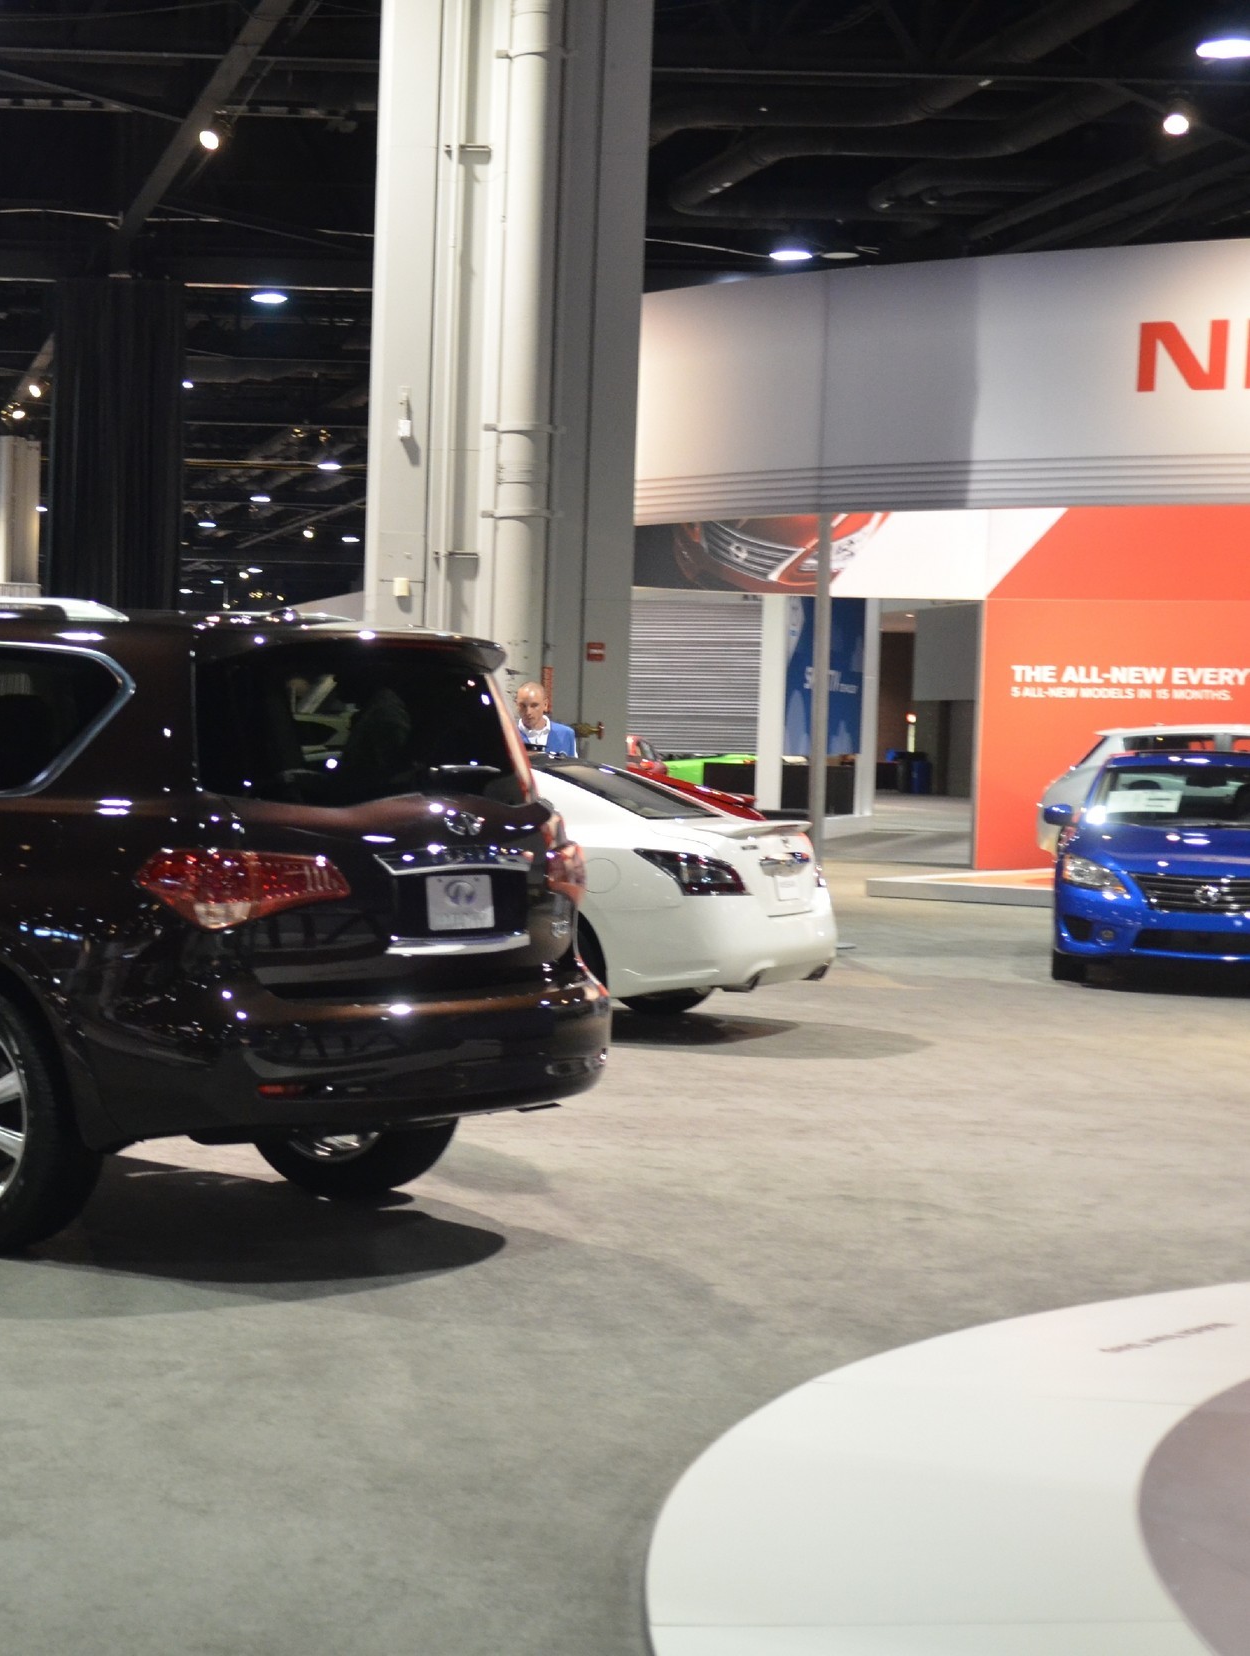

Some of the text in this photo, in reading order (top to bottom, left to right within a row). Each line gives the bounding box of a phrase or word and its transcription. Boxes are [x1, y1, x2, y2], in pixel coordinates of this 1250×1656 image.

[1010, 664, 1057, 683] THE
[1061, 665, 1167, 684] ALL-NEW
[1010, 686, 1021, 698] 5
[1022, 686, 1078, 698] ALL-NEW
[1079, 687, 1135, 699] MODELS
[1137, 688, 1152, 699] IN
[1155, 688, 1170, 699] 15
